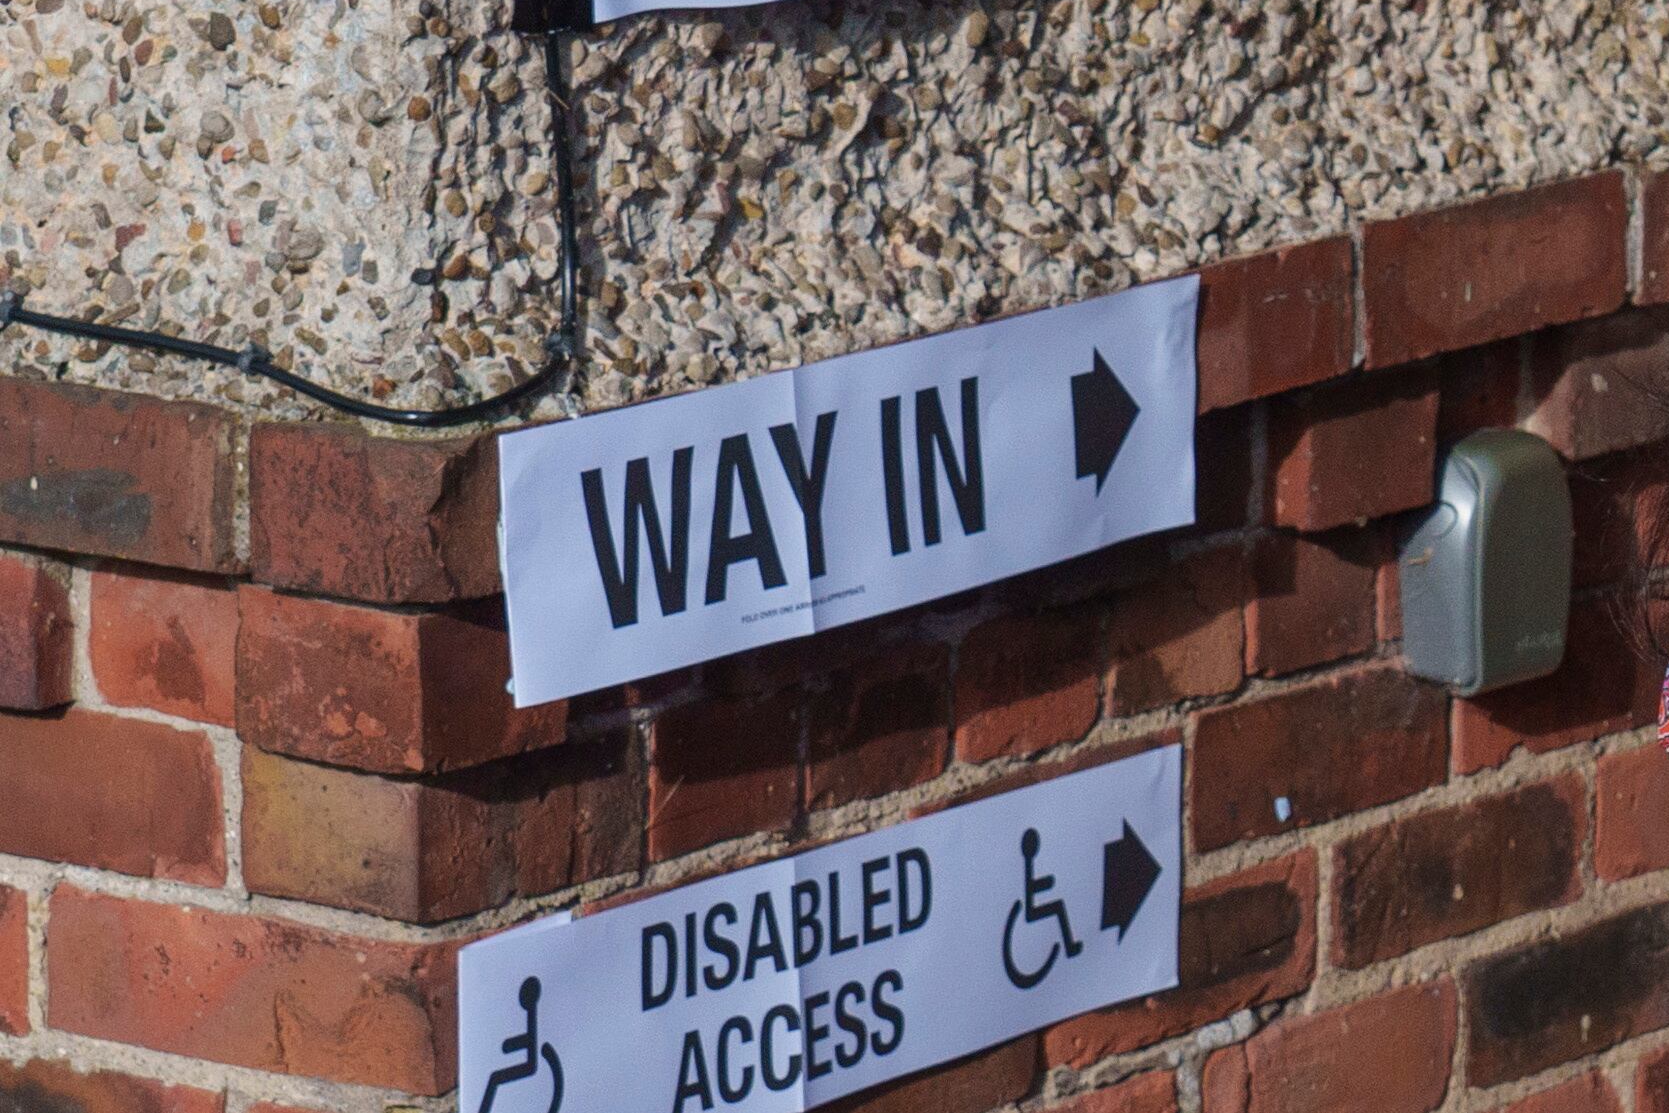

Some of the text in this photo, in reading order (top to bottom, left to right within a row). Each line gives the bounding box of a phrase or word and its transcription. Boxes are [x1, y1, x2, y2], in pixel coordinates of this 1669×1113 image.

[580, 375, 987, 630] WAY IN
[641, 847, 933, 1012] DISABLED
[672, 969, 905, 1113] ACCESS
